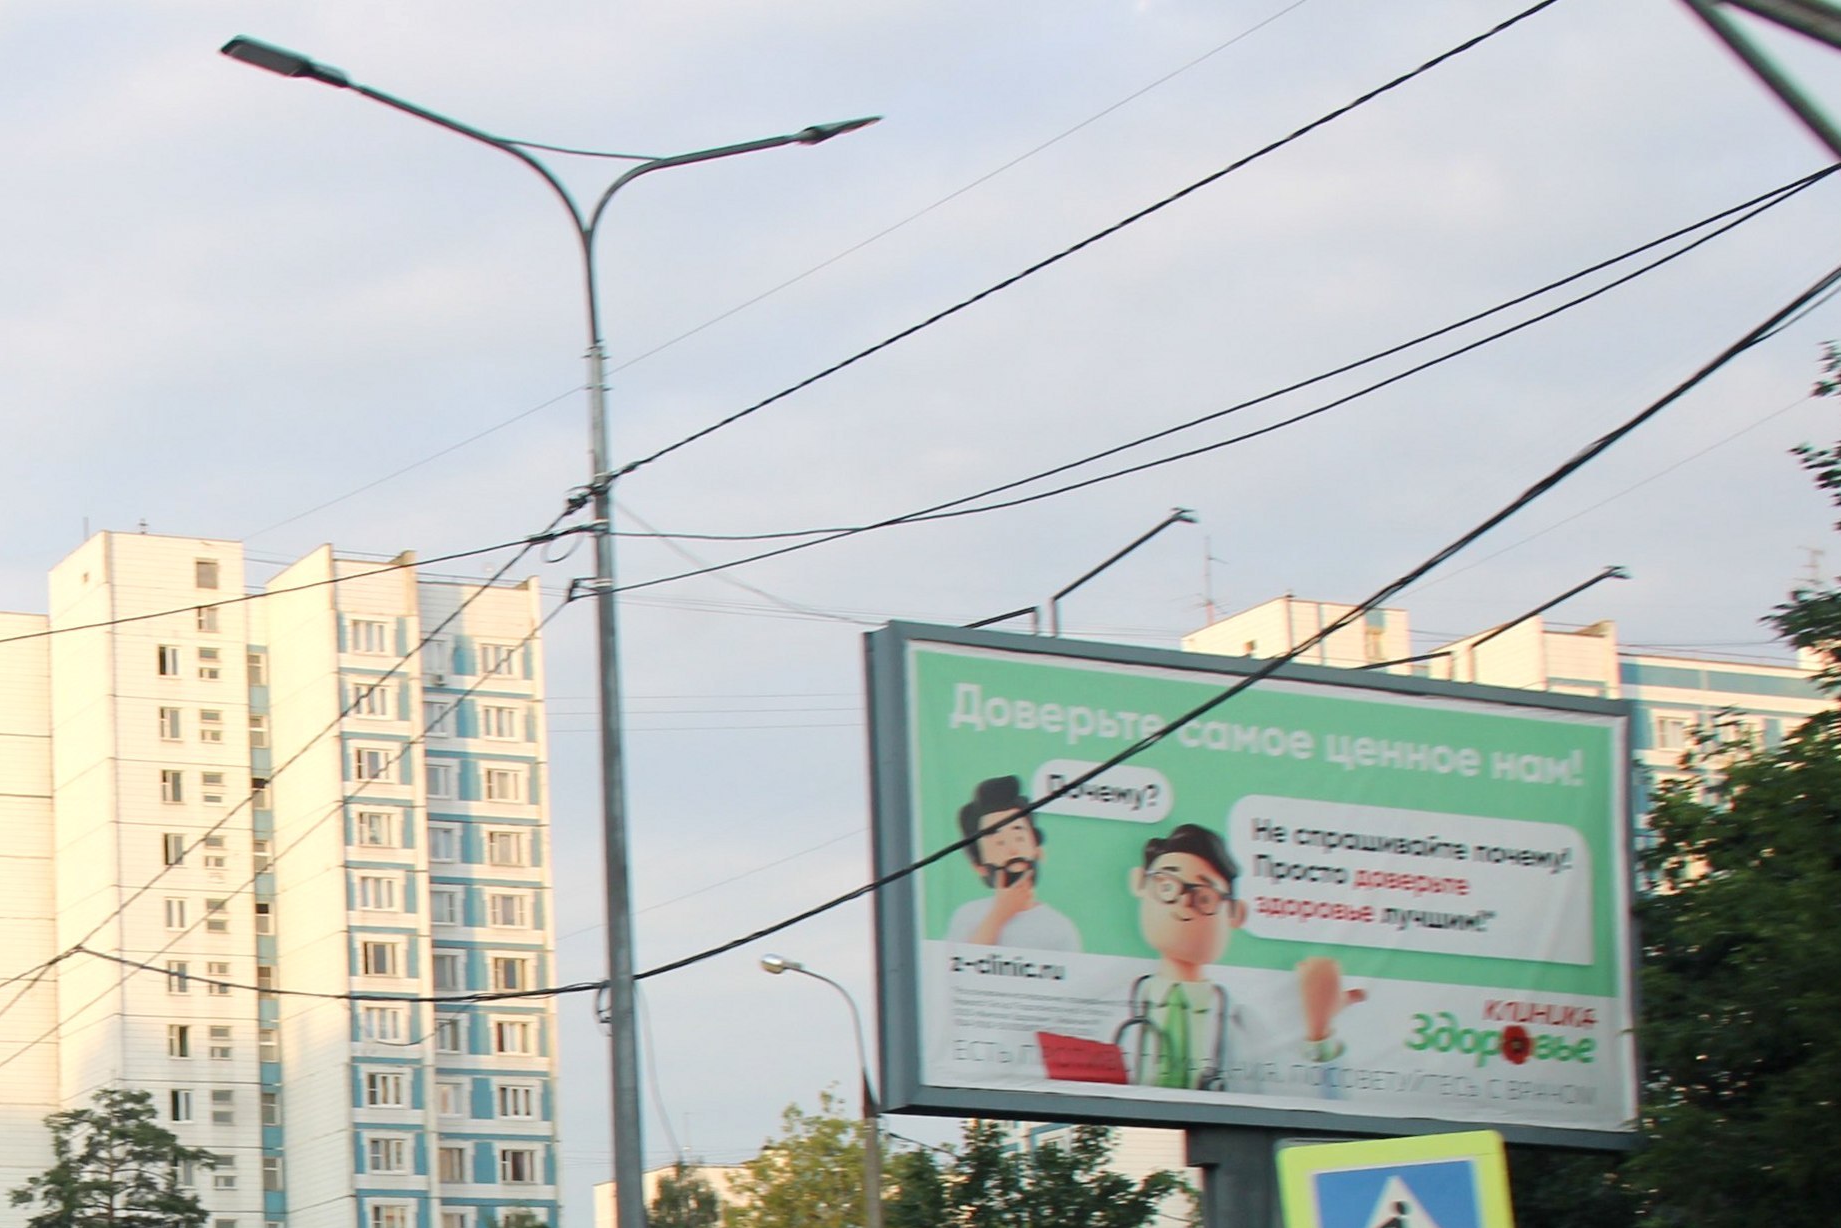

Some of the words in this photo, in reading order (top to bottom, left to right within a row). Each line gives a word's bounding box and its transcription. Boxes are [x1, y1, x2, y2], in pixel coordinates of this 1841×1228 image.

[949, 683, 1164, 744] Доверьте
[1178, 719, 1314, 760] самое
[1323, 732, 1481, 776] ценное
[1490, 749, 1585, 786] нам!
[1251, 817, 1287, 843] Не
[1293, 826, 1469, 861] спрашивайте
[1253, 853, 1348, 886] Просто
[1352, 868, 1471, 897] доверьте
[1254, 895, 1376, 924] здоровье
[950, 953, 1065, 981] z-clinic.ru
